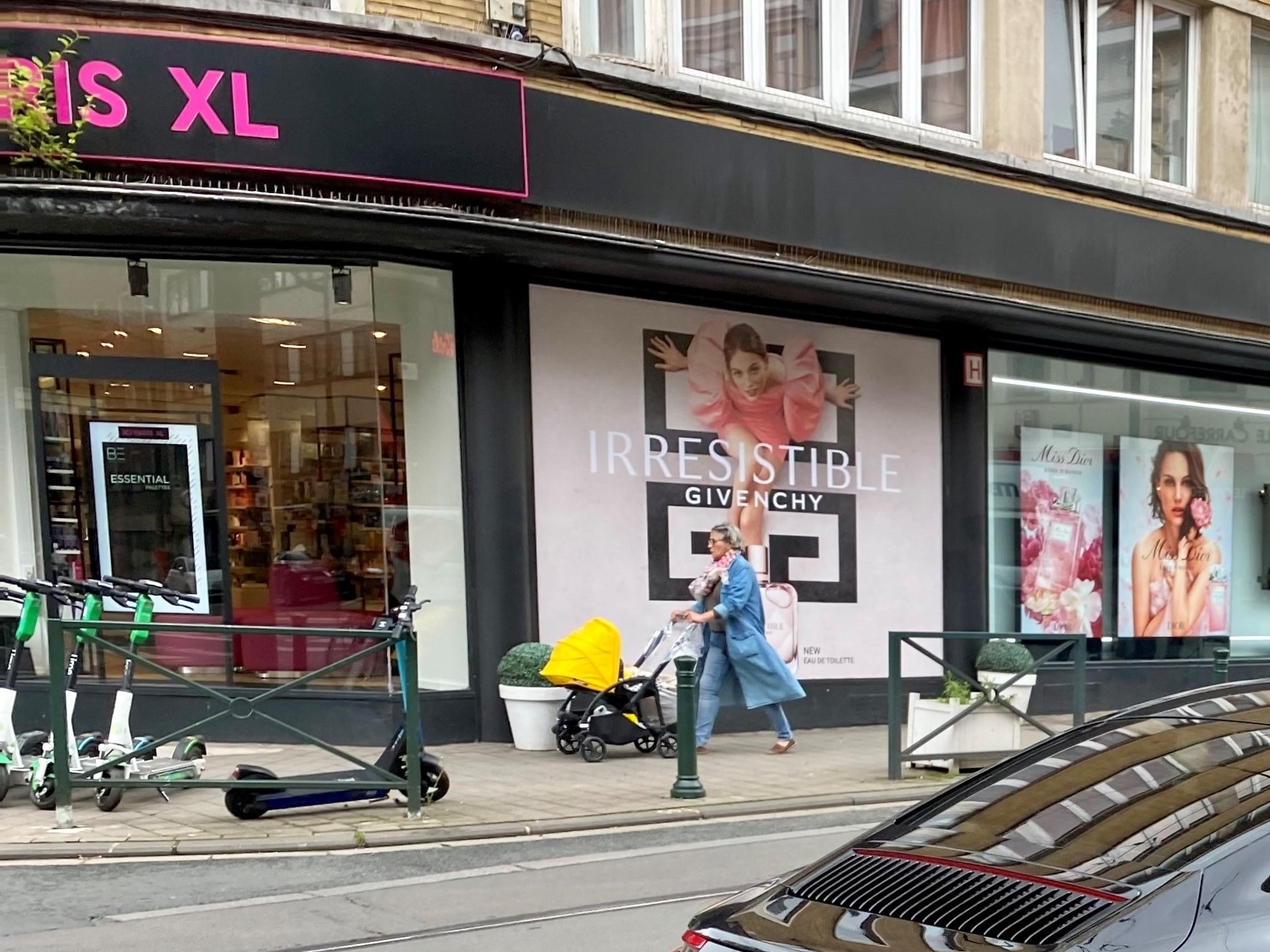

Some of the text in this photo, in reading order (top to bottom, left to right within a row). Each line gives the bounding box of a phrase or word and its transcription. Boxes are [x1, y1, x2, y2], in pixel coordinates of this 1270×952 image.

[167, 66, 279, 139] XL
[589, 430, 901, 493] IRRESISTIBLE
[1031, 444, 1093, 465] Miss Dior
[110, 474, 170, 484] ESSENTIAL
[685, 486, 823, 511] GIVENCHY
[1181, 540, 1210, 561] Dior
